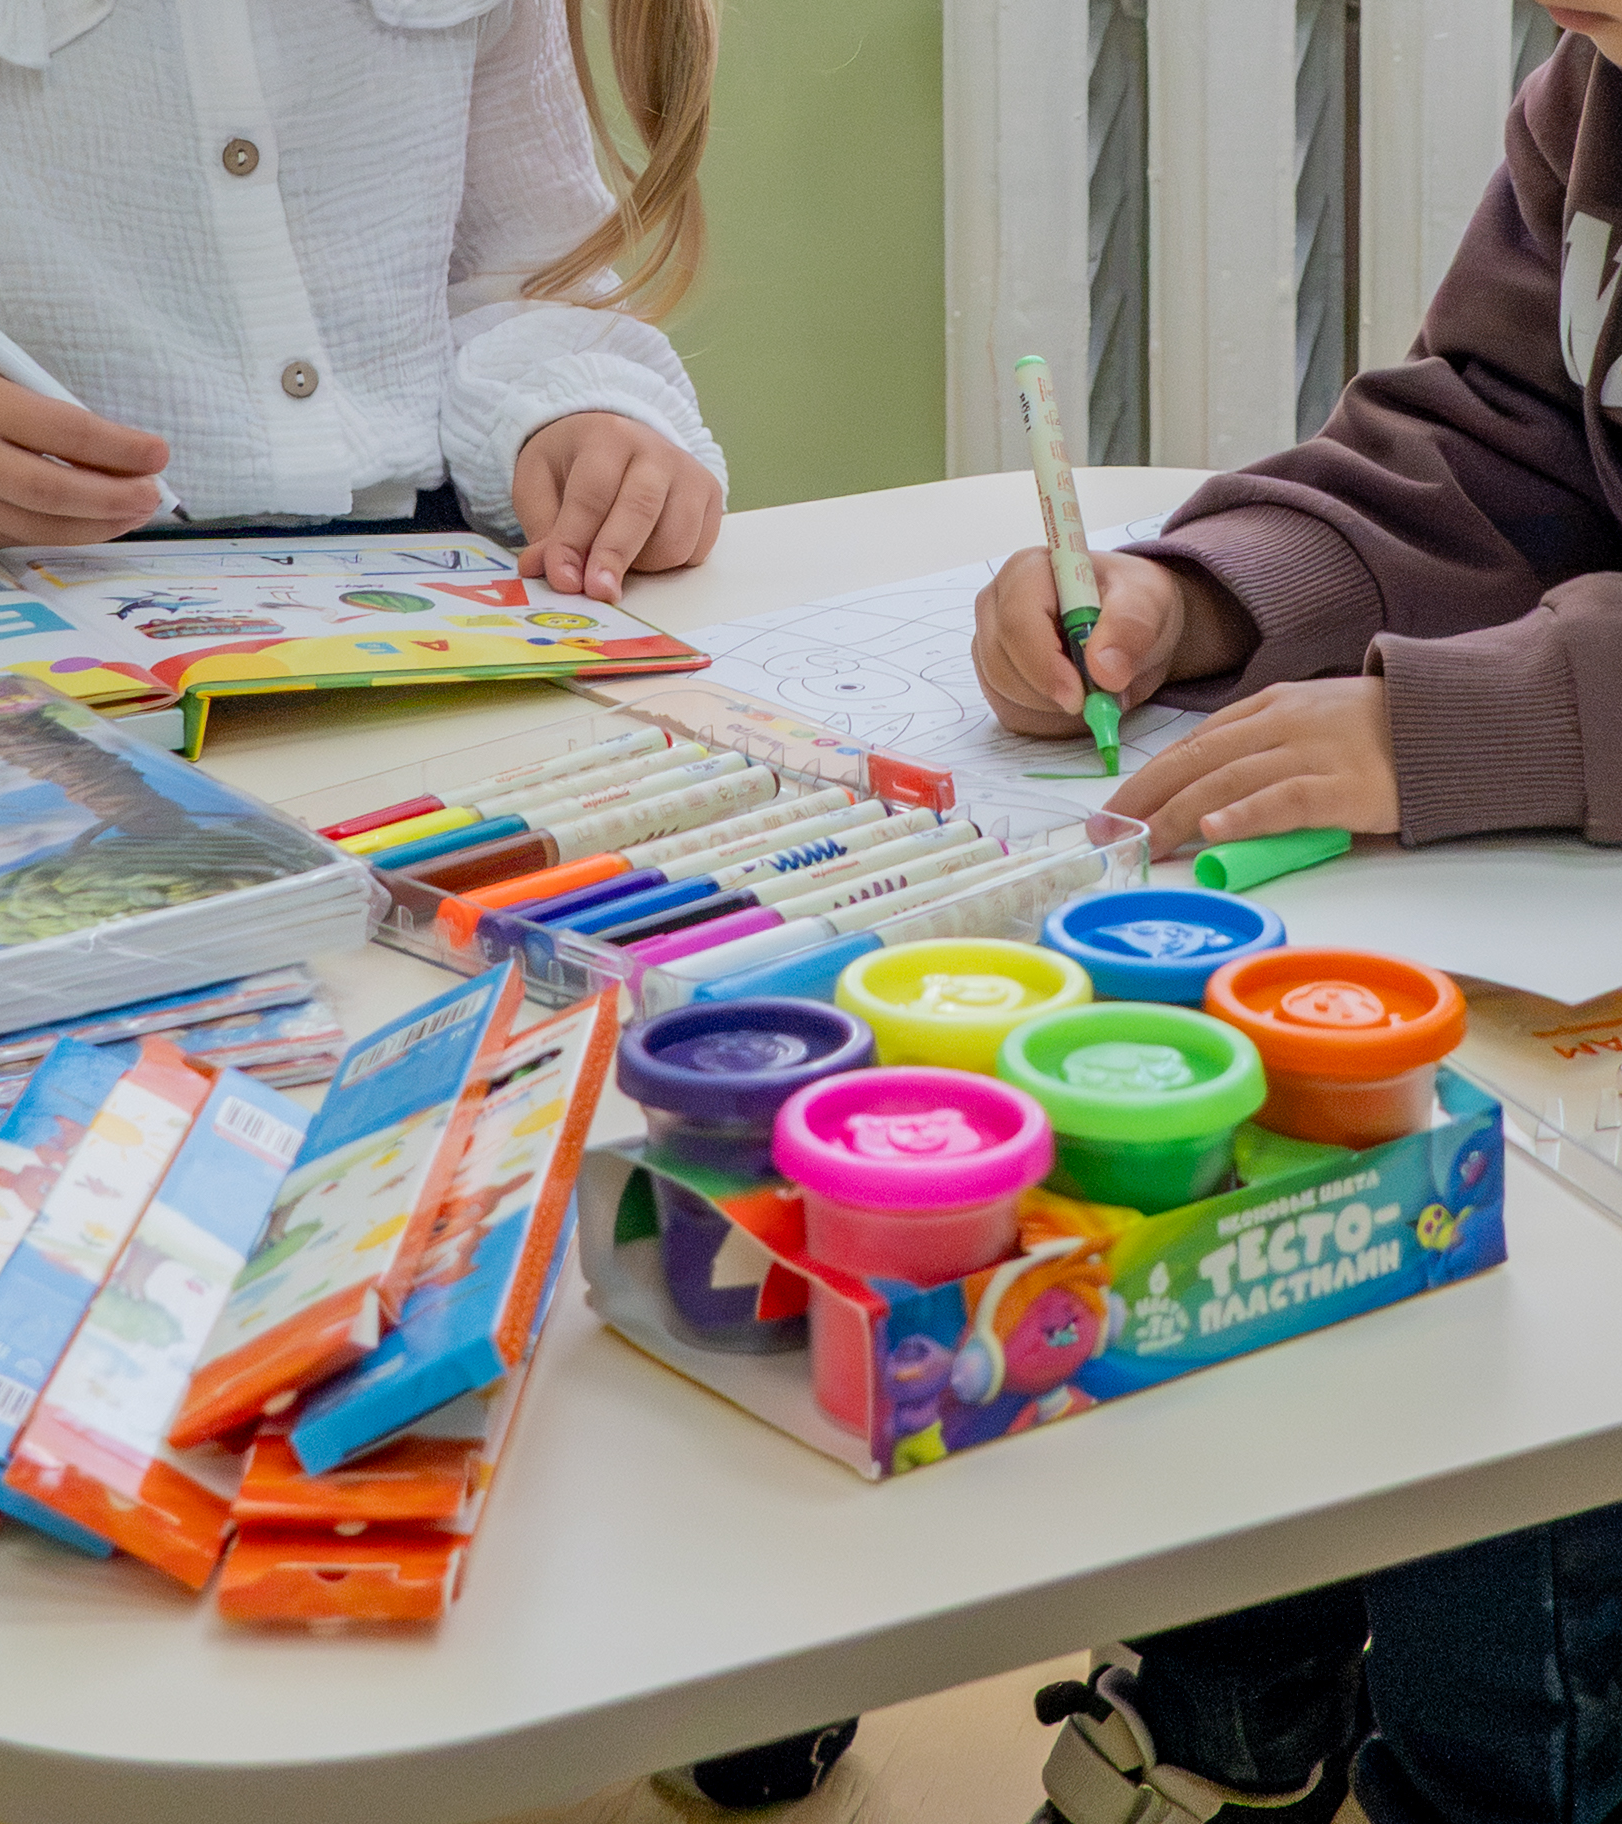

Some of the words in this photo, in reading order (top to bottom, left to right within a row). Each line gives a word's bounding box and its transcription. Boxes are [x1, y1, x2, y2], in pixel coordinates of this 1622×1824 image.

[415, 578, 530, 607] А
[1199, 1203, 1400, 1298] ТЕСТО-
[1200, 1240, 1400, 1335] ПЛАСТИЛИН
